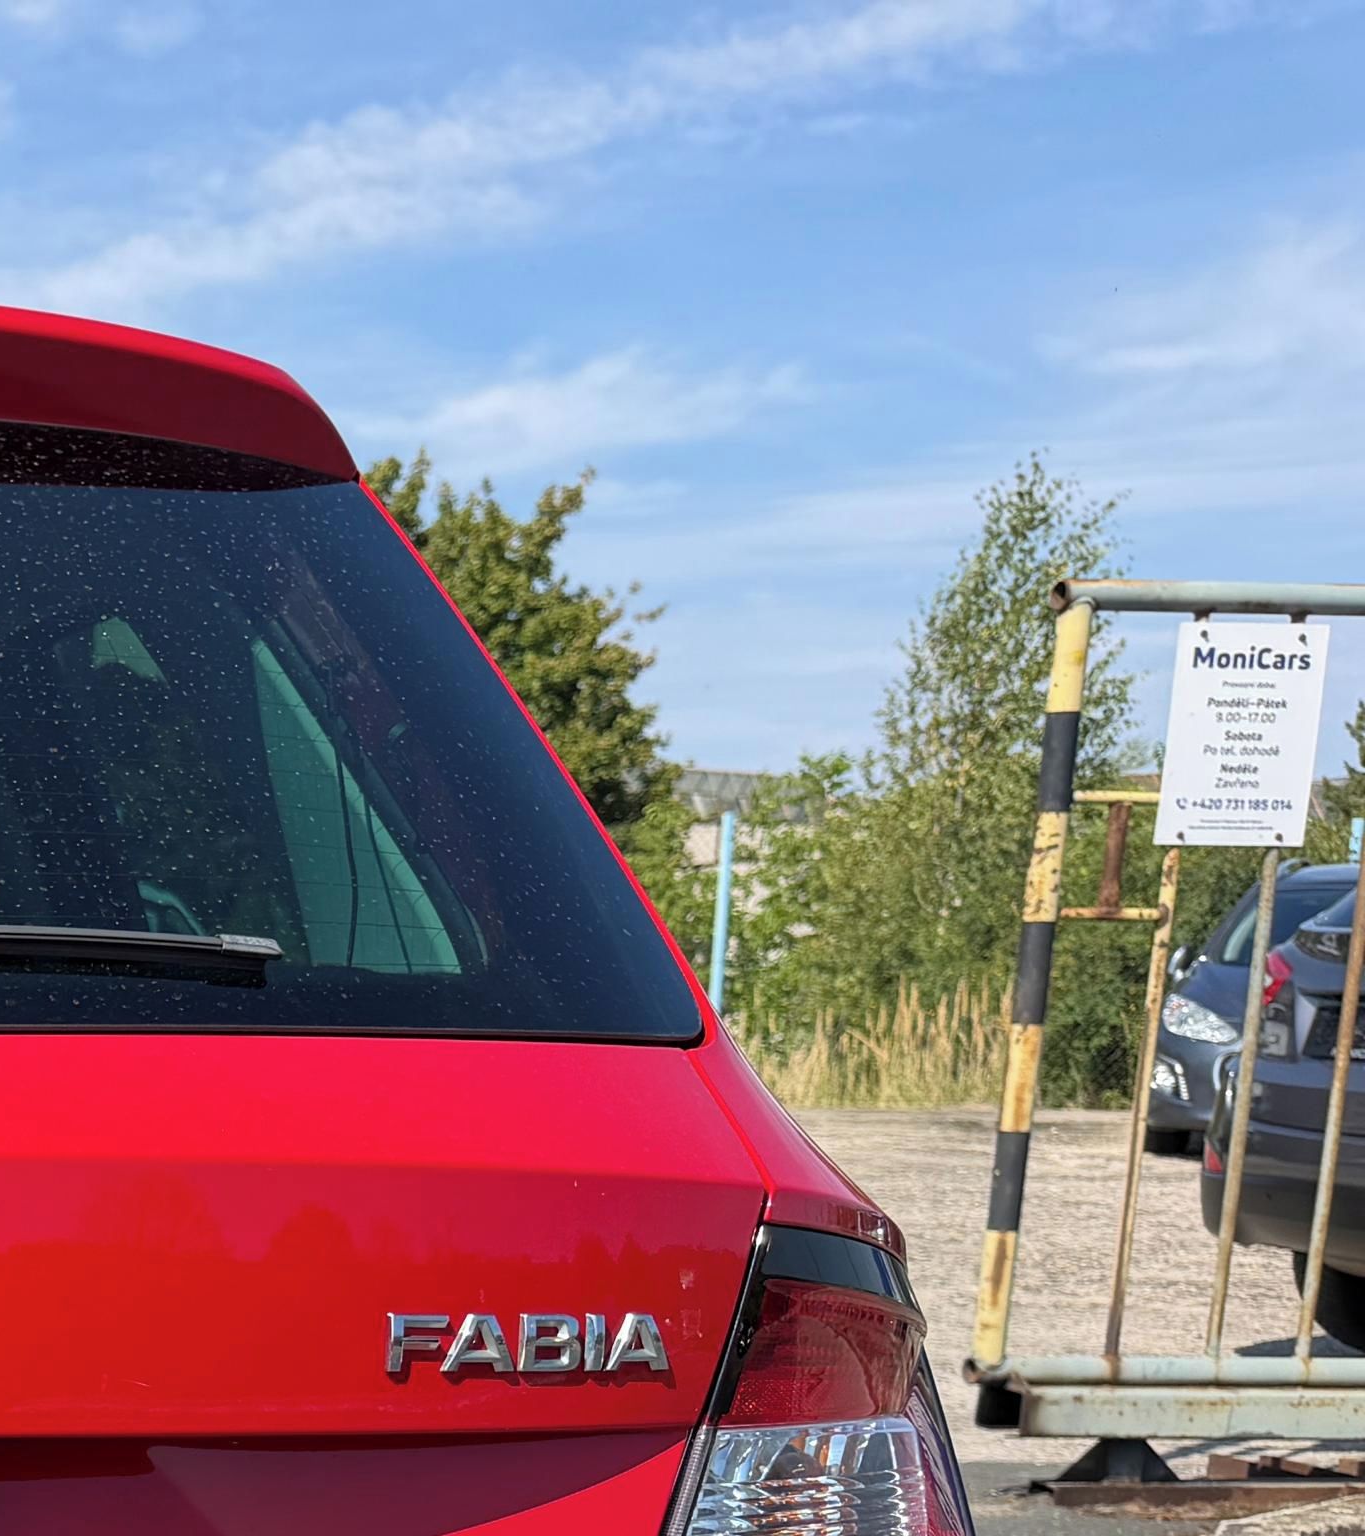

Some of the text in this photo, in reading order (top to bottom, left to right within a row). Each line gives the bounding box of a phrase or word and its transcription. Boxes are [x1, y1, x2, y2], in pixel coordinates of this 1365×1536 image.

[1192, 645, 1311, 670] MoniCars
[1224, 730, 1263, 742] Sobota
[1203, 744, 1218, 755] Po
[1220, 763, 1259, 775] Neděle
[1214, 777, 1260, 789] Zavřeno
[1191, 798, 1293, 811] +420 731 185 014
[385, 1312, 670, 1373] FABIA
